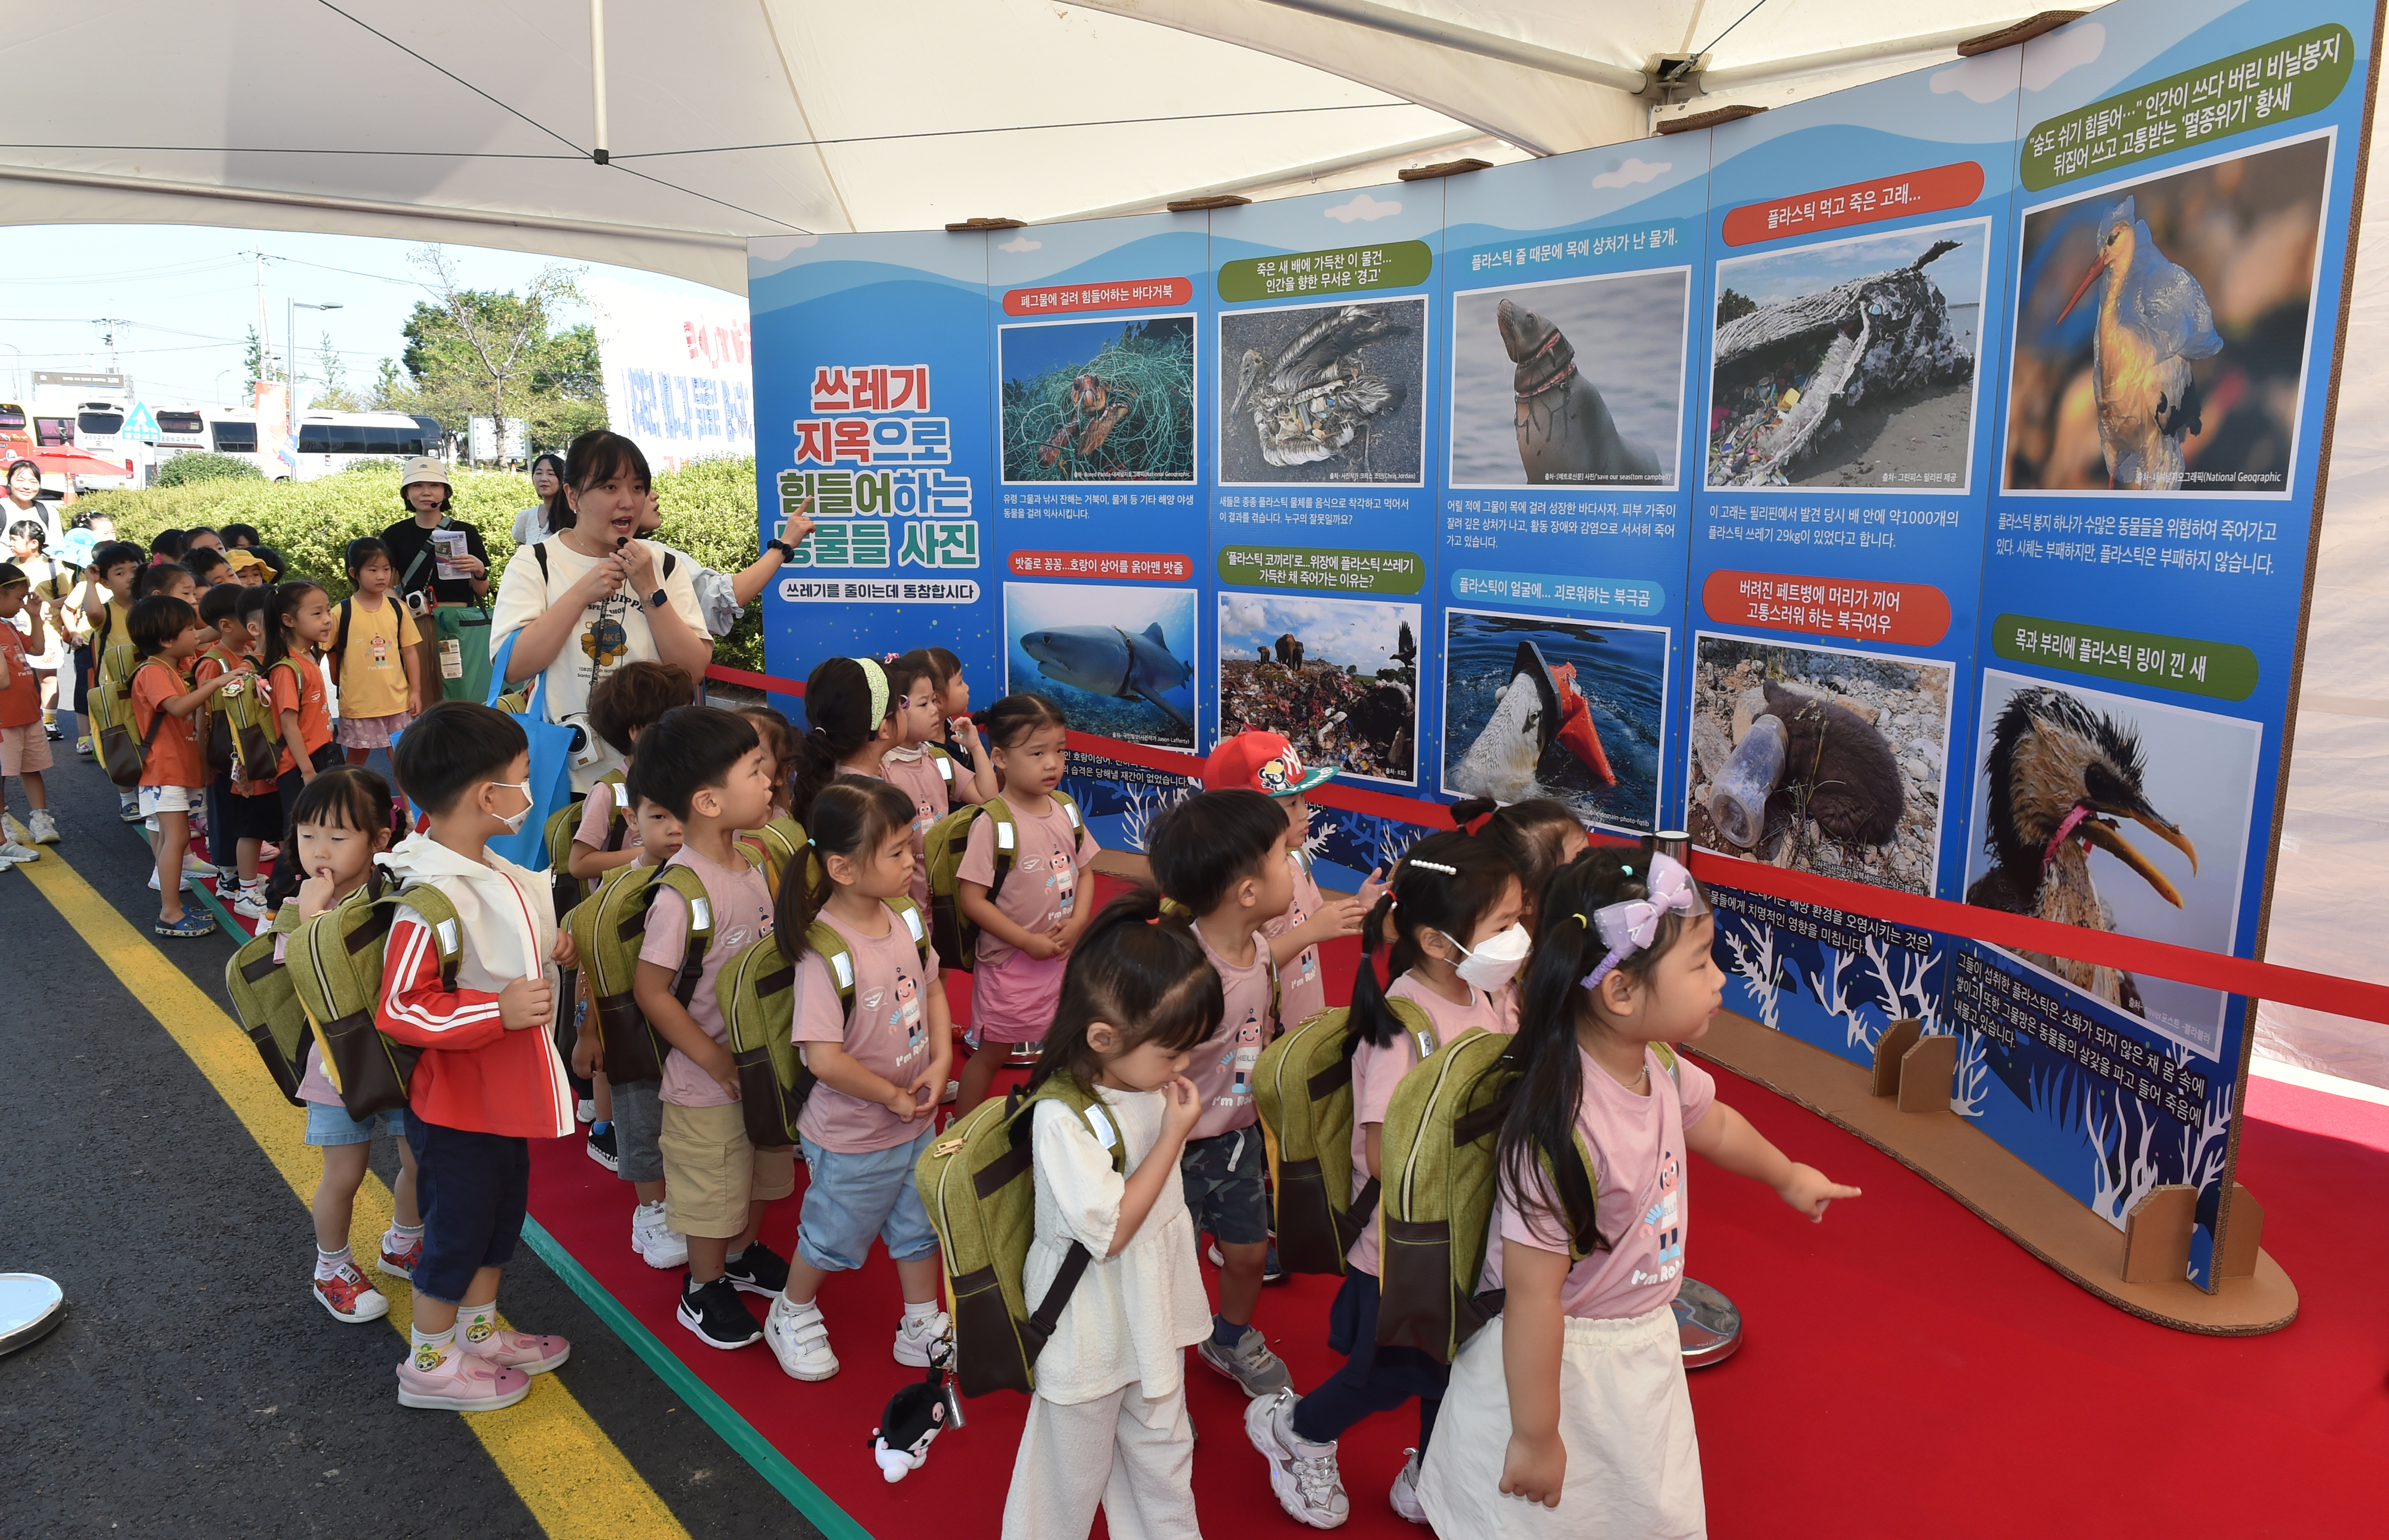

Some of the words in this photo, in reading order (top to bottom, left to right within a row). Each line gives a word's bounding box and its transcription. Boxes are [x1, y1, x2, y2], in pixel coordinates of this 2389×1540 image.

[2058, 118, 2081, 147] 쉬기
[2146, 82, 2188, 120] 인간이
[2191, 70, 2225, 103] 쓰다
[2228, 58, 2262, 91] 버린
[2267, 33, 2340, 79] 비닐봉지
[2053, 144, 2089, 176] 뒤집어
[2091, 137, 2117, 164] 쓰고
[2120, 120, 2177, 155] 고통받는
[2255, 81, 2292, 118] 황새
[1767, 201, 1814, 229] 플라스틱
[1820, 197, 1844, 218] 먹고
[1849, 190, 1876, 213] 죽은
[1880, 183, 1920, 205] 고래...
[1472, 249, 1512, 271] 플라스틱
[1515, 248, 1526, 265] 줄
[1530, 242, 1562, 262] 때문에
[1566, 239, 1589, 257] 목에
[1593, 233, 1629, 254] 상처가
[1633, 231, 1645, 250] 난
[1649, 228, 1678, 248] 물개.
[1257, 262, 1276, 277] 죽은
[1278, 260, 1288, 274] 새
[1291, 257, 1310, 273] 배에
[1314, 253, 1344, 271] 가득찬
[1347, 252, 1357, 268] 이
[1361, 250, 1391, 266] 물건...
[1266, 276, 1295, 293] 인간을
[1298, 273, 1318, 290] 향한
[1321, 271, 1351, 288] 무서운
[1021, 293, 1057, 308] 폐그물에
[1060, 291, 1077, 305] 걸려
[1082, 288, 1129, 303] 힘들어하는
[1132, 284, 1172, 300] 바다거북
[814, 367, 927, 410] 쓰레기
[797, 420, 948, 463] 지옥으로
[1898, 472, 1922, 482] 그린피스
[1924, 472, 1942, 482] 필리핀
[1943, 473, 1957, 482] 제공
[779, 472, 971, 514] 힘들어하는
[1003, 494, 1017, 504] 유령
[1020, 494, 1041, 504] 그물과
[1043, 494, 1057, 504] 낚시
[1060, 494, 1082, 504] 잔해는
[1085, 494, 1109, 505] 거북이,
[1111, 494, 1127, 505] 물개
[1129, 494, 1138, 505] 등
[1140, 494, 1156, 505] 기타
[1158, 494, 1175, 505] 해양
[1177, 494, 1193, 505] 야생
[1219, 496, 1240, 507] 새들은
[1242, 496, 1257, 508] 종종
[1258, 496, 1287, 508] 플라스틱
[1290, 497, 1313, 508] 물체를
[1315, 497, 1346, 508] 음식으로
[1349, 497, 1381, 509] 착각하고
[1384, 498, 1408, 509] 먹어서
[1003, 508, 1025, 518] 동물을
[1027, 508, 1041, 518] 걸려
[1043, 508, 1089, 519] 익사시킵니다.
[1447, 500, 1462, 512] 어릴
[1465, 500, 1480, 512] 적에
[1482, 500, 1507, 513] 그물이
[1509, 501, 1526, 514] 목에
[1529, 501, 1546, 514] 걸려
[1549, 502, 1576, 515] 성장한
[1579, 502, 1619, 516] 바다사자.
[1622, 503, 1642, 517] 피부
[1645, 503, 1675, 518] 가죽이
[1710, 505, 1718, 518] 이
[1720, 505, 1747, 520] 고래는
[1750, 506, 1797, 521] 필리핀에서
[1801, 507, 1820, 522] 발견
[1824, 508, 1844, 523] 당시
[1848, 508, 1859, 523] 배
[1863, 508, 1885, 524] 안에
[1889, 509, 1958, 527] 약1000개의
[1998, 513, 2031, 530] 플라스틱
[2033, 514, 2051, 531] 봉지
[2053, 514, 2083, 533] 하나가
[2084, 516, 2115, 534] 수많은
[2118, 517, 2164, 537] 동물들을
[2166, 518, 2217, 540] 위협하여
[2221, 520, 2276, 542] 죽어가고
[901, 523, 975, 564] 사진
[1015, 557, 1042, 570] 밧줄로
[1100, 559, 1128, 573] 상어를
[1131, 560, 1160, 573] 옭아맨
[1163, 561, 1183, 574] 밧줄
[1340, 556, 1380, 572] 플라스틱
[1382, 558, 1412, 573] 쓰레기
[1260, 568, 1286, 583] 가득찬
[1288, 570, 1297, 584] 채
[1300, 571, 1337, 586] 죽어가는
[1340, 573, 1374, 588] 이유는?
[787, 583, 839, 597] 쓰레기를
[845, 584, 898, 598] 줄이는데
[904, 584, 974, 599] 동참합시다
[1459, 577, 1507, 596] 플라스틱이
[1510, 581, 1550, 598] 얼굴에...
[1554, 584, 1610, 604] 괴로워하는
[1614, 588, 1650, 607] 북극곰
[1740, 579, 1773, 600] 버려진
[1776, 582, 1825, 605] 페트병에
[1829, 586, 1868, 608] 머리가
[1872, 590, 1900, 611] 끼어
[1747, 603, 1804, 625] 고통스러워
[1808, 608, 1833, 628] 하는
[1837, 610, 1891, 634] 북극여우
[2015, 628, 2037, 653] 목과
[2040, 632, 2075, 660] 부리에
[2079, 638, 2132, 669] 플라스틱
[2136, 647, 2165, 675] 링이
[2170, 653, 2185, 678] 낀
[2189, 656, 2206, 682] 새
[1071, 766, 1093, 776] 습격은
[1095, 768, 1118, 779] 당해낼
[1120, 771, 1143, 782] 재간이
[1146, 773, 1188, 786] 없었습니다.
[1748, 903, 1785, 927] 치명적인
[1788, 917, 1817, 939] 영향을
[1821, 927, 1866, 954] 미칩니다.
[1811, 904, 1843, 925] 환경을
[1846, 915, 1901, 943] 오염시키는
[1905, 933, 1929, 952] 것은
[905, 1005, 919, 1018] HELLO
[1954, 999, 1977, 1023] 내몰고
[1979, 1015, 2015, 1048] 있습니다.
[896, 1053, 912, 1067] I'm
[1212, 1096, 1233, 1106] I'm
[1631, 1269, 1658, 1285] I'm
